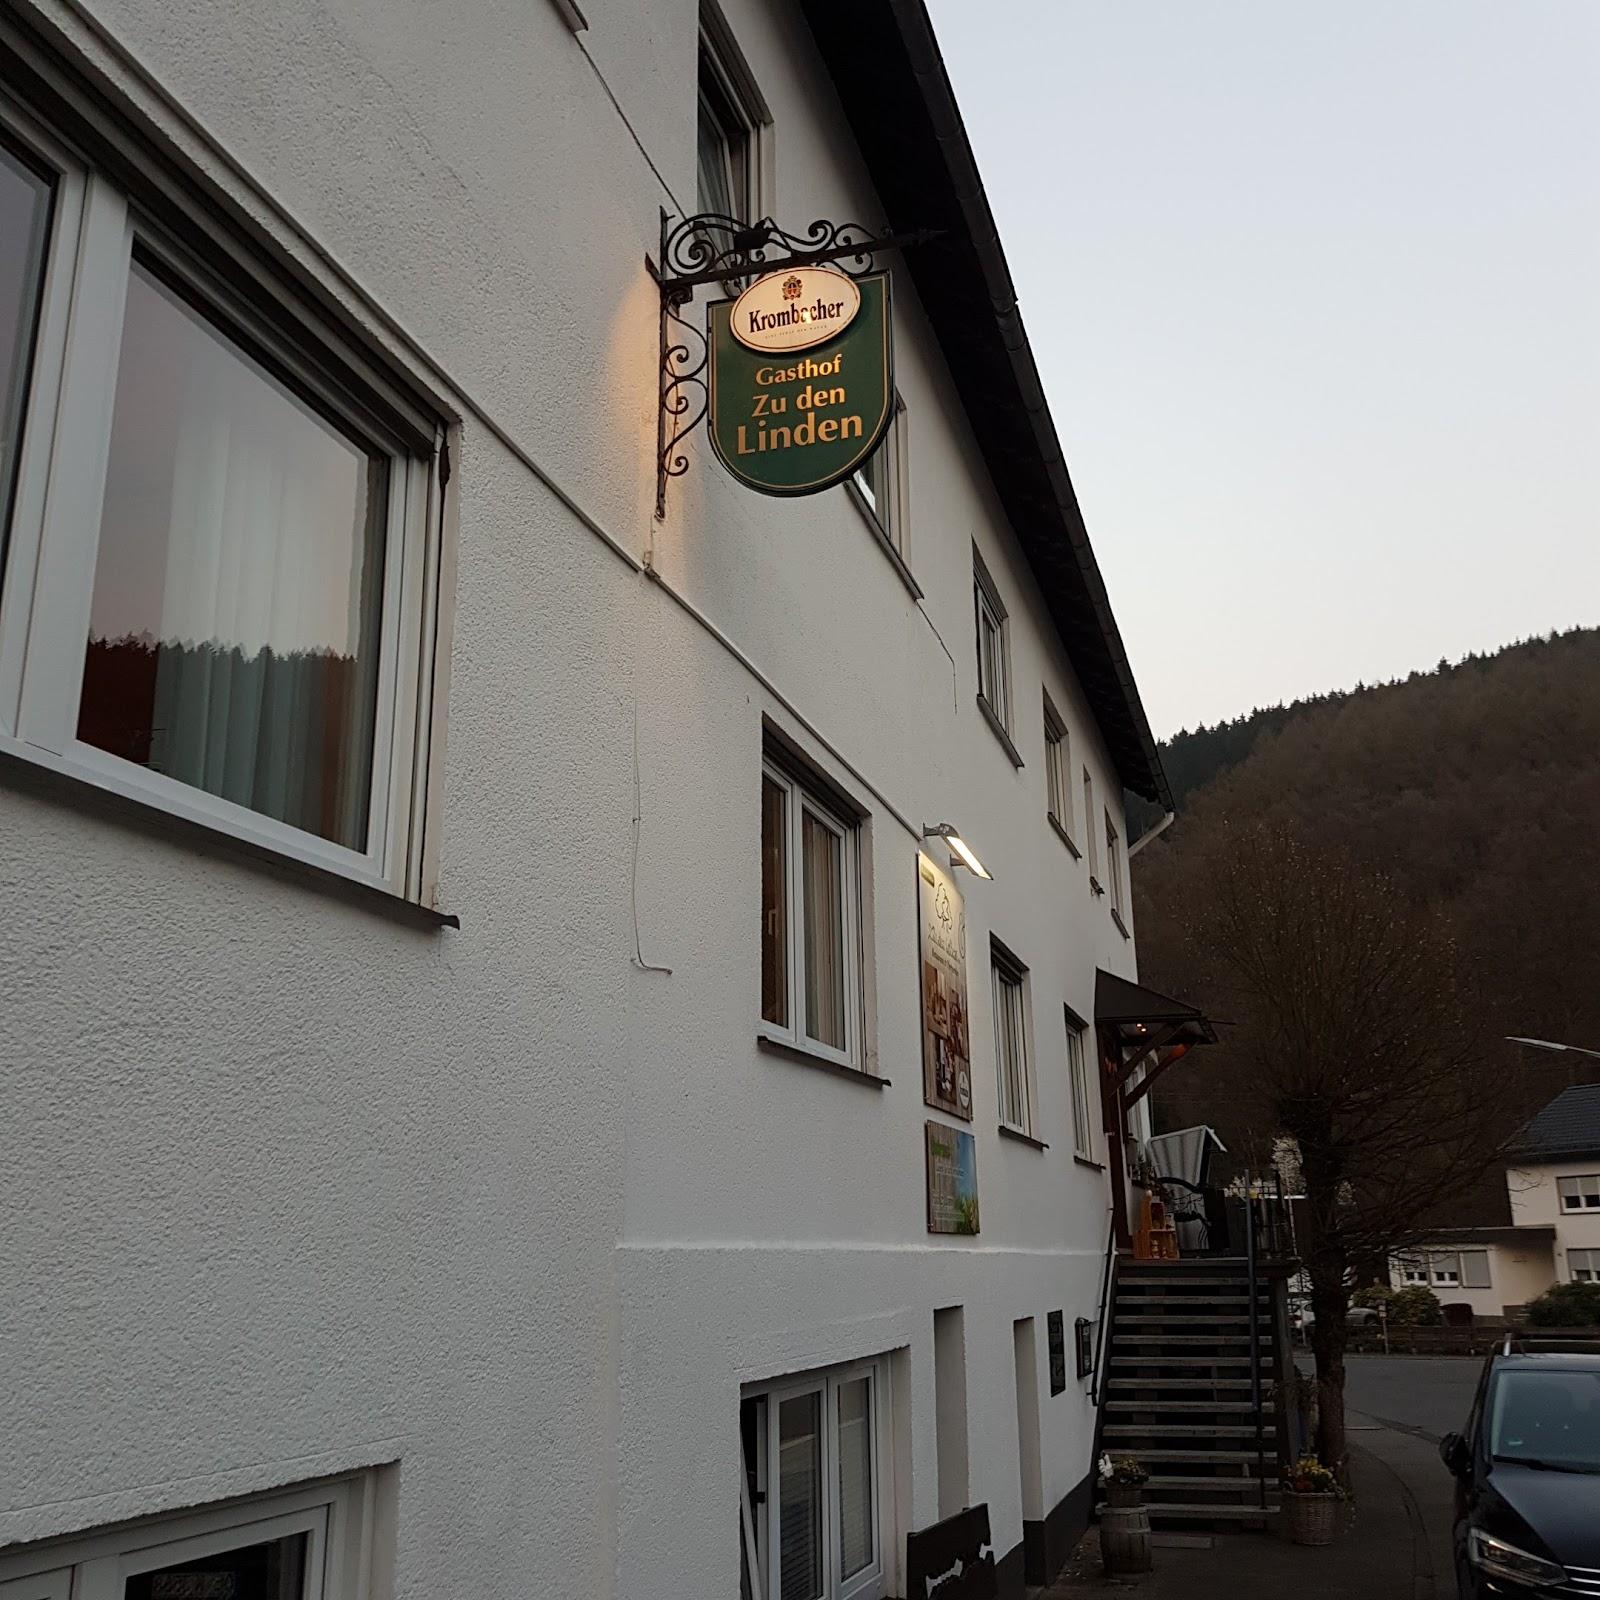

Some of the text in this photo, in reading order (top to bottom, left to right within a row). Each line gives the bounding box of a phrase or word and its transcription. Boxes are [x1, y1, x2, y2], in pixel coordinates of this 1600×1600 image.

[749, 298, 844, 333] Krombacher
[756, 354, 842, 385] Gasthof
[752, 385, 845, 417] Zu den
[737, 412, 863, 455] Linden
